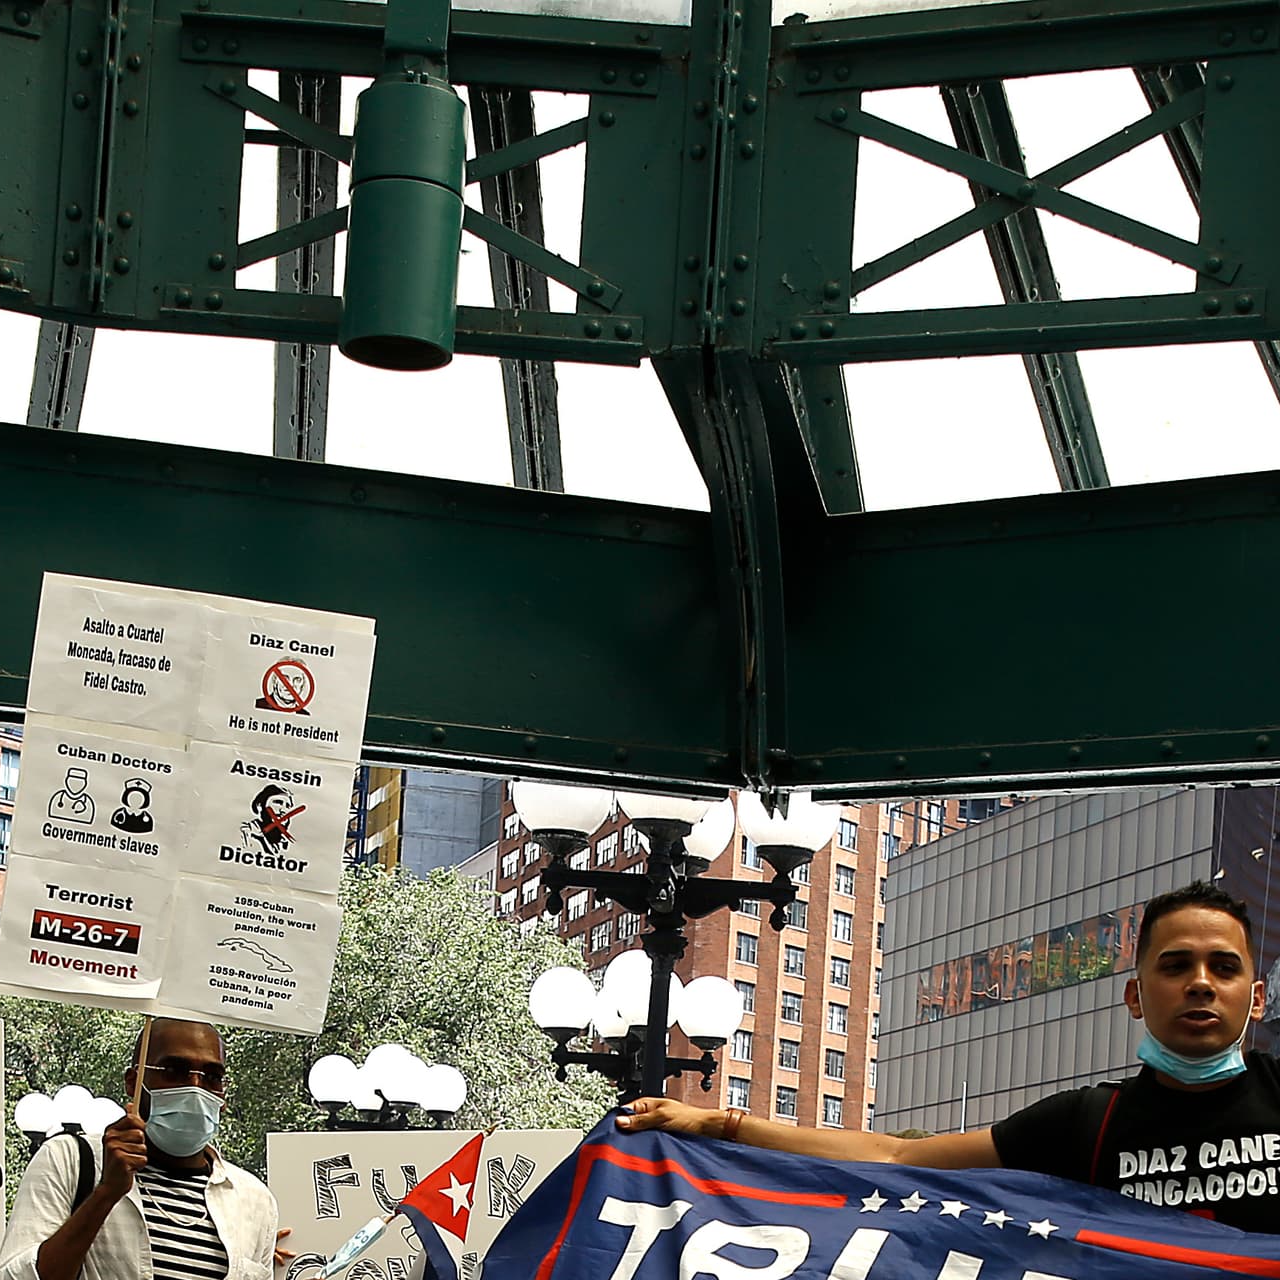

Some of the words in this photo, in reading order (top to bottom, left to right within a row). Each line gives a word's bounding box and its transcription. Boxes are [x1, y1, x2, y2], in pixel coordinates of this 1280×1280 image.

[83, 617, 115, 636] Asalto
[118, 626, 124, 637] a
[127, 623, 164, 643] Cuartel
[67, 641, 116, 667] Moncada,
[119, 650, 155, 669] fracaso
[158, 656, 171, 672] de
[249, 633, 284, 650] Diaz
[289, 640, 335, 657] Canel
[84, 671, 108, 690] Fidel
[112, 676, 147, 696] Castro.
[228, 715, 245, 729] He
[248, 717, 259, 731] is
[261, 720, 280, 735] not
[283, 722, 339, 743] President
[57, 743, 106, 763] Cuban
[111, 753, 172, 774] Doctors
[230, 760, 322, 787] Assassin
[42, 822, 117, 849] Government
[120, 836, 159, 856] slaves
[219, 845, 308, 873] Dictator
[46, 884, 134, 911] Terrorist
[234, 896, 294, 914] 1959-Cuban
[39, 916, 128, 947] M-26-7
[287, 919, 316, 931] worst
[30, 949, 138, 979] Movement
[1119, 1145, 1187, 1178] DIAZ
[312, 1152, 536, 1219] FUK
